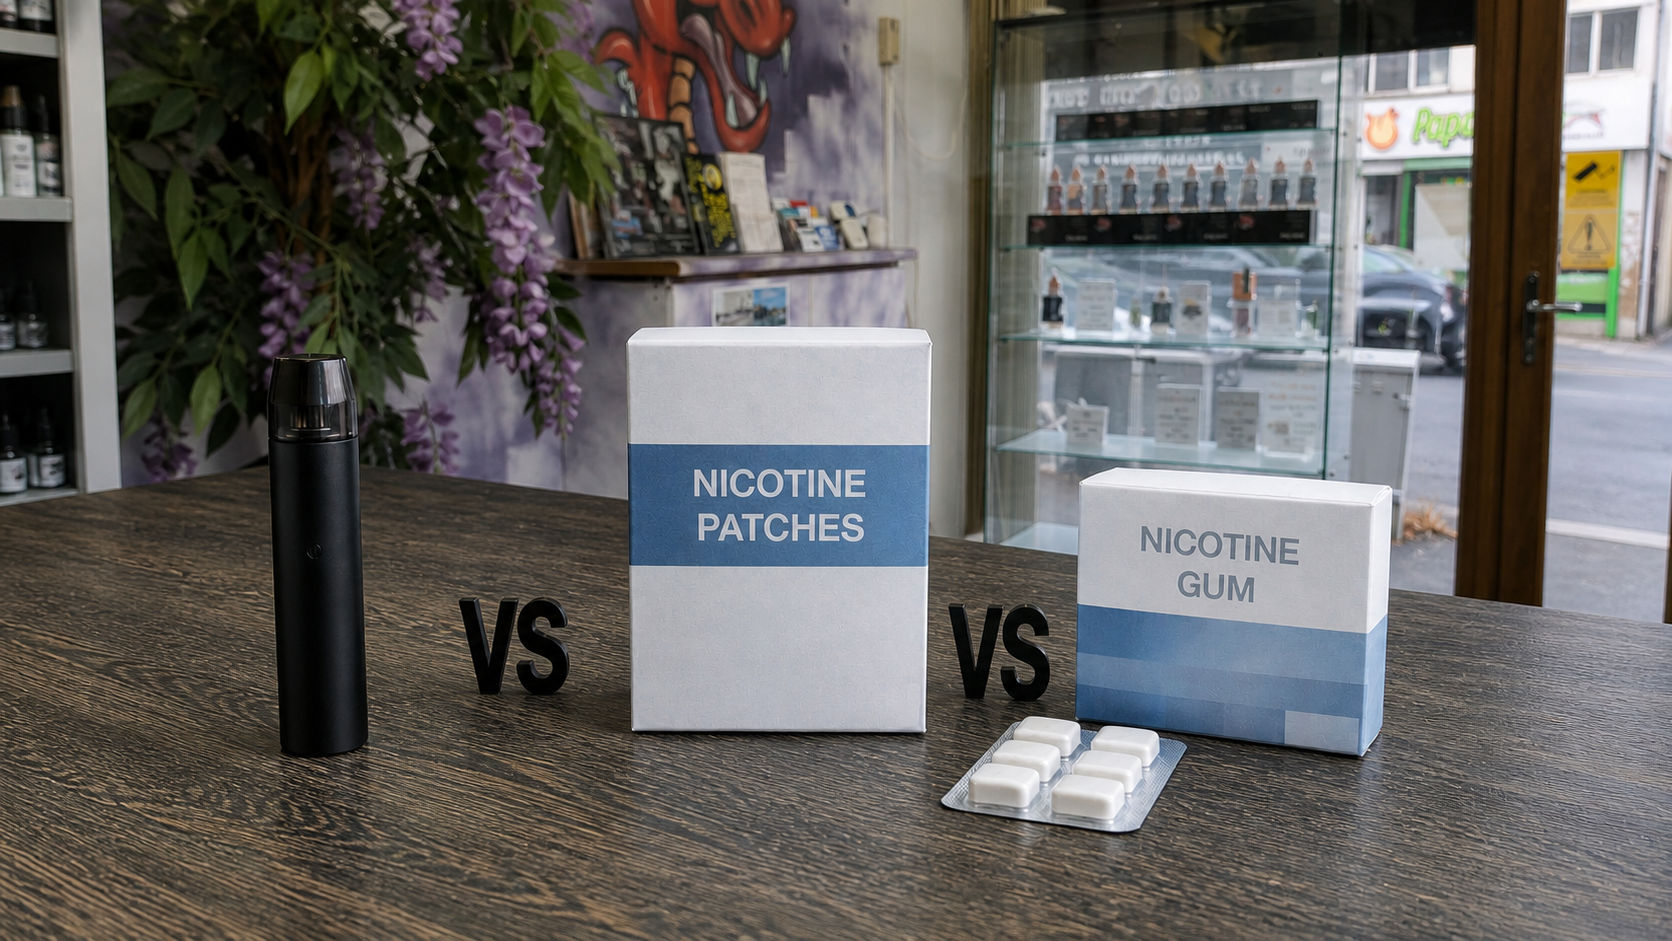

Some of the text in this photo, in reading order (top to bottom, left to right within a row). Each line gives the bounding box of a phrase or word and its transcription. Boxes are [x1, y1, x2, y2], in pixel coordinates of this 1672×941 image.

[693, 468, 867, 498] NICOTINE
[697, 512, 865, 543] PATCHES
[1140, 525, 1300, 566] NICOTINE
[1177, 570, 1255, 603] GUM
[458, 597, 571, 696] VS
[948, 602, 1050, 701] VS
